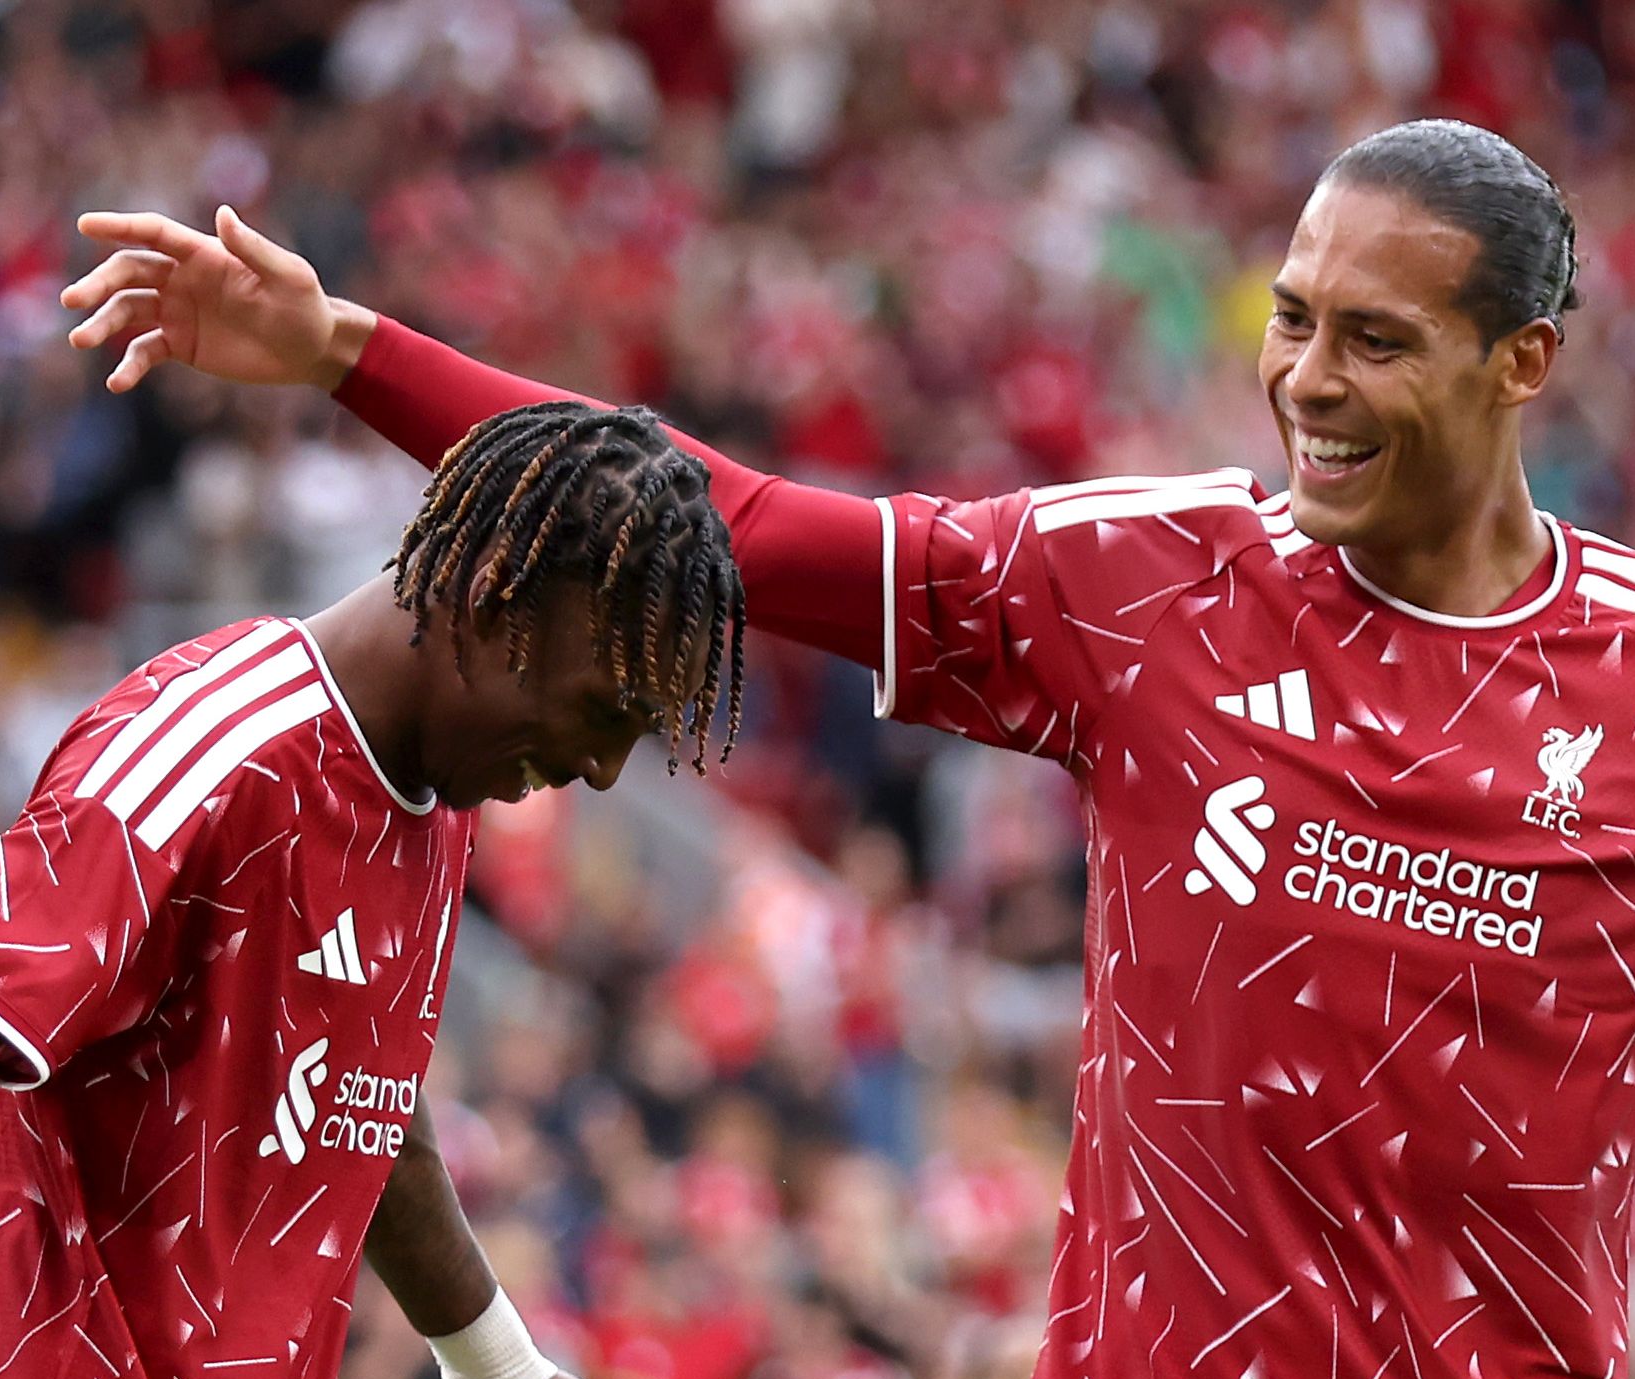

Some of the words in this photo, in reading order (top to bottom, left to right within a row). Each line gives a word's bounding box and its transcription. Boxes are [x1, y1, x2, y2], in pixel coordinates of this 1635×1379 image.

[1521, 795, 1581, 839] L.F.C.
[1284, 861, 1543, 957] chartered
[1293, 818, 1540, 911] standard
